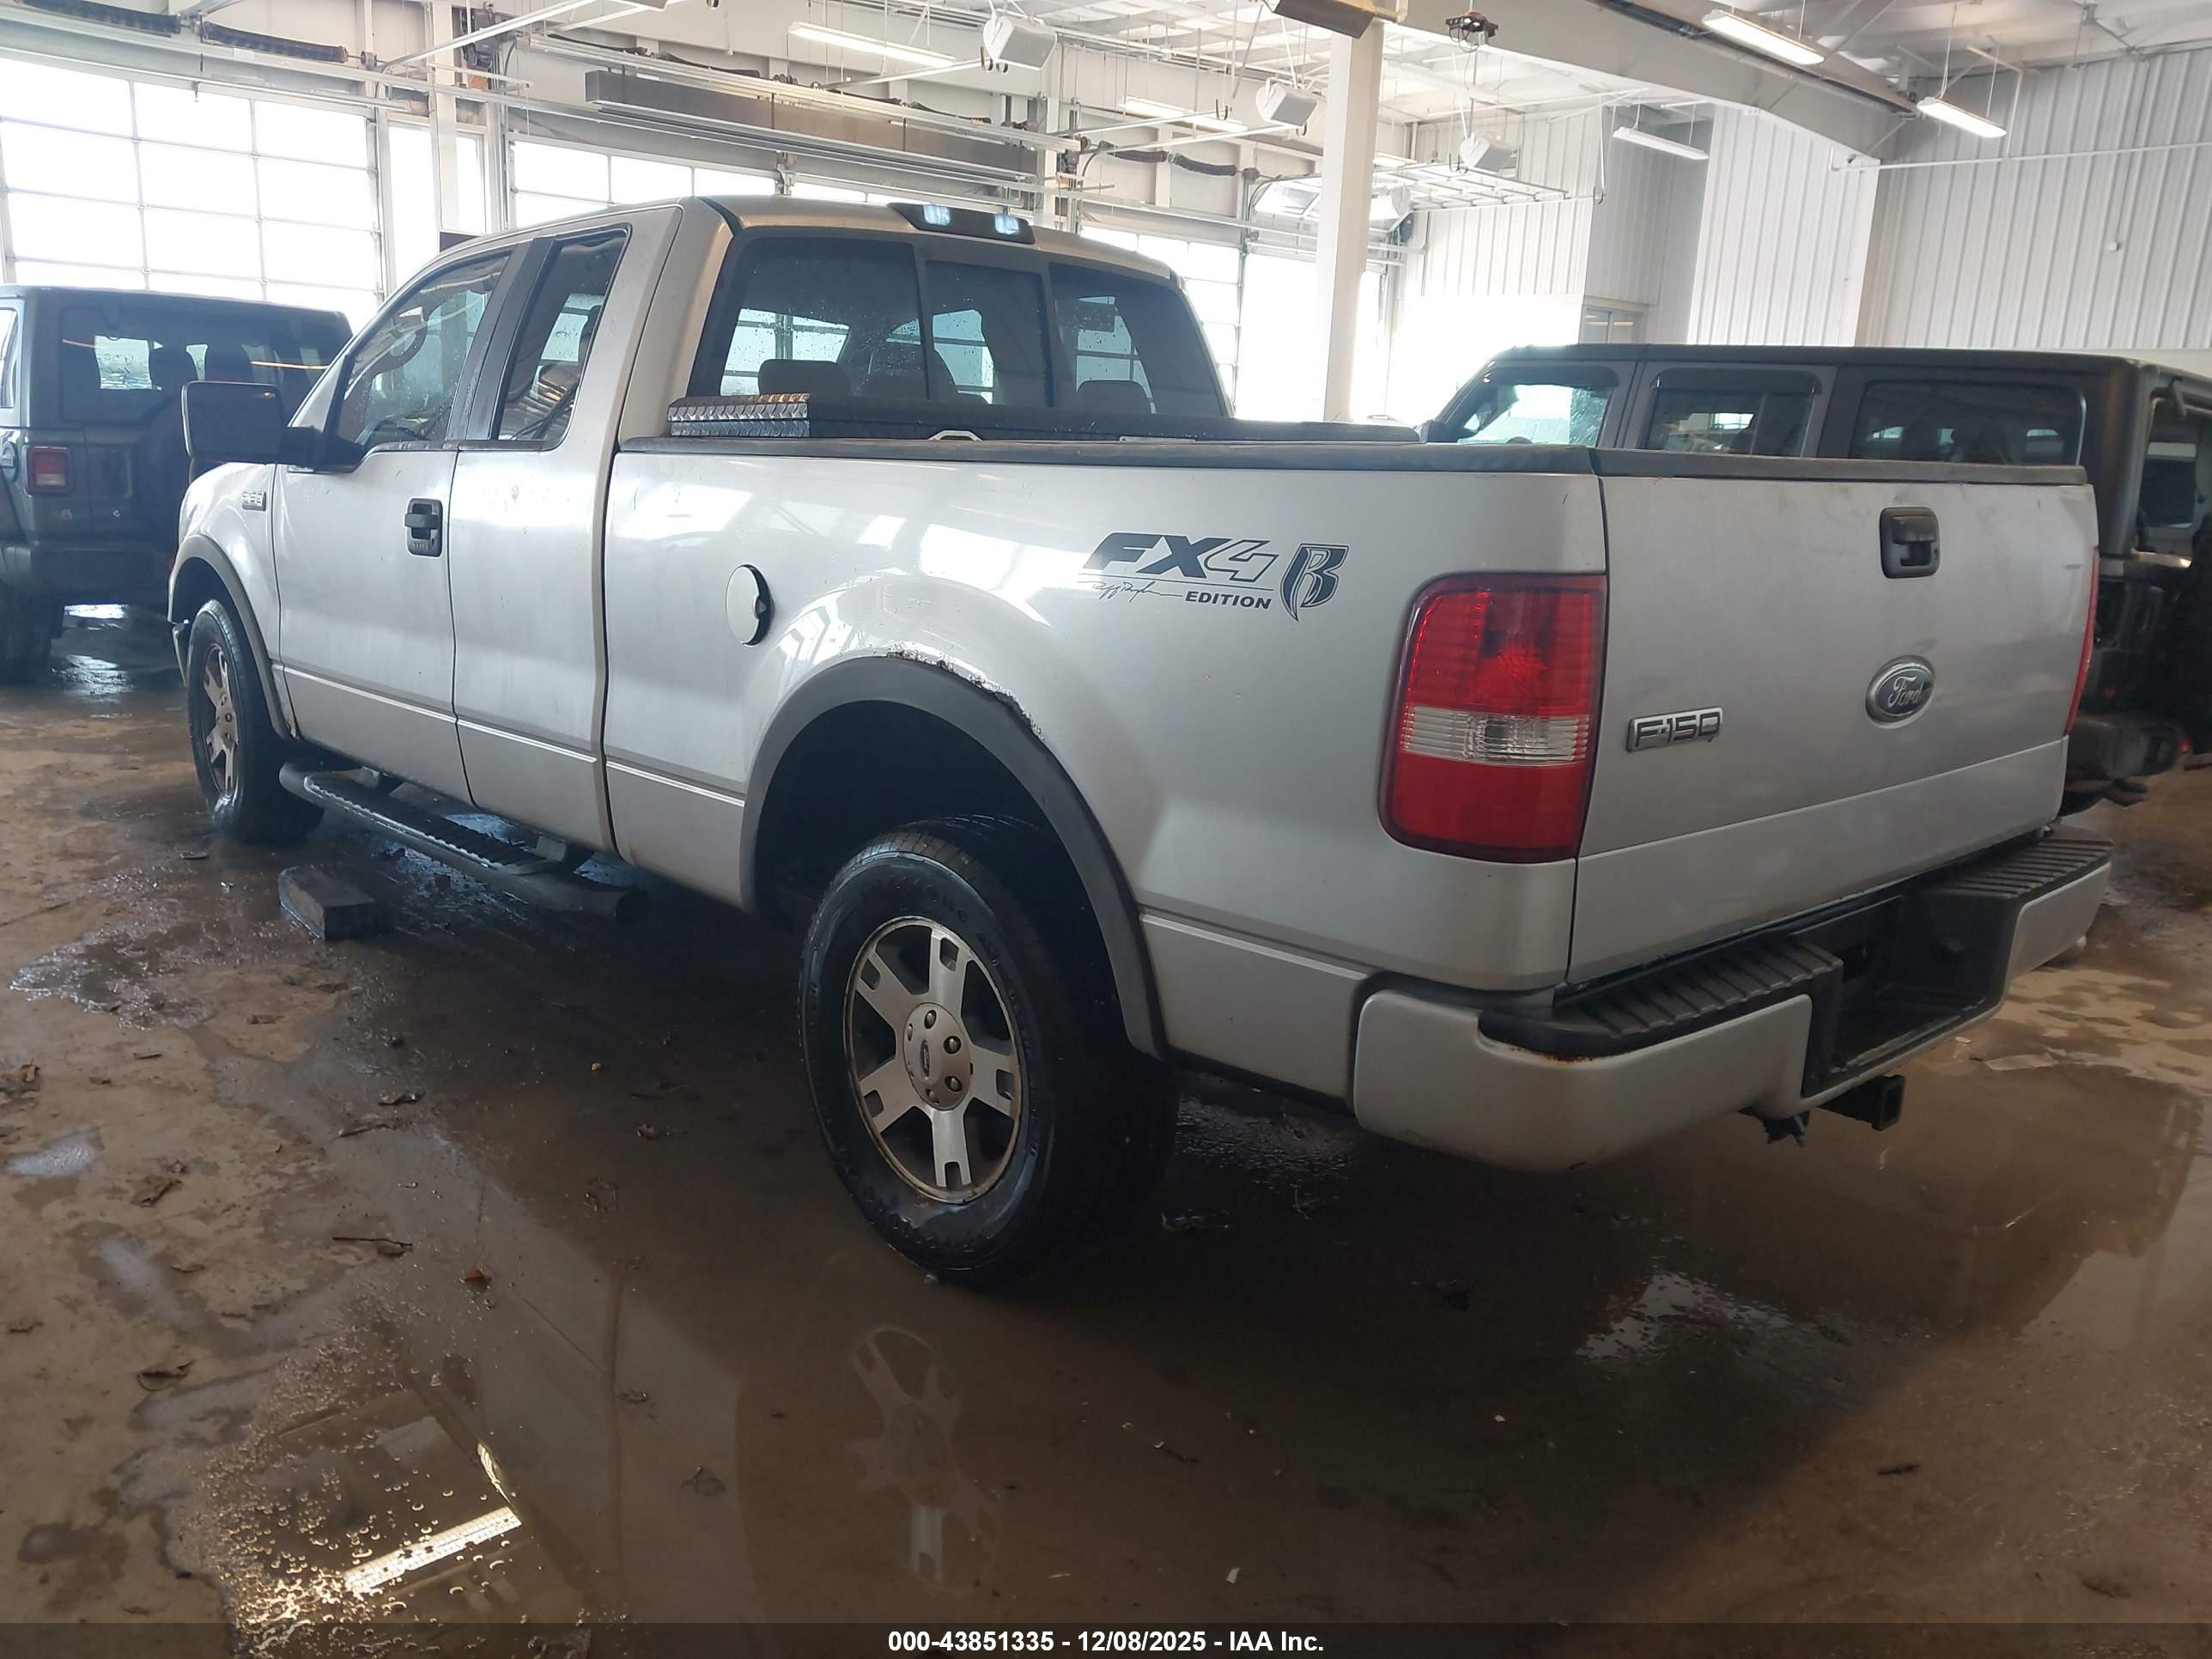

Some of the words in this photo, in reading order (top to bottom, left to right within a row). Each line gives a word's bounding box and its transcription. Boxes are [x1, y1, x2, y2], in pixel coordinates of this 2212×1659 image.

[1082, 532, 1279, 583] FX4
[1185, 590, 1272, 610] EDITION
[1887, 675, 1924, 708] Ford
